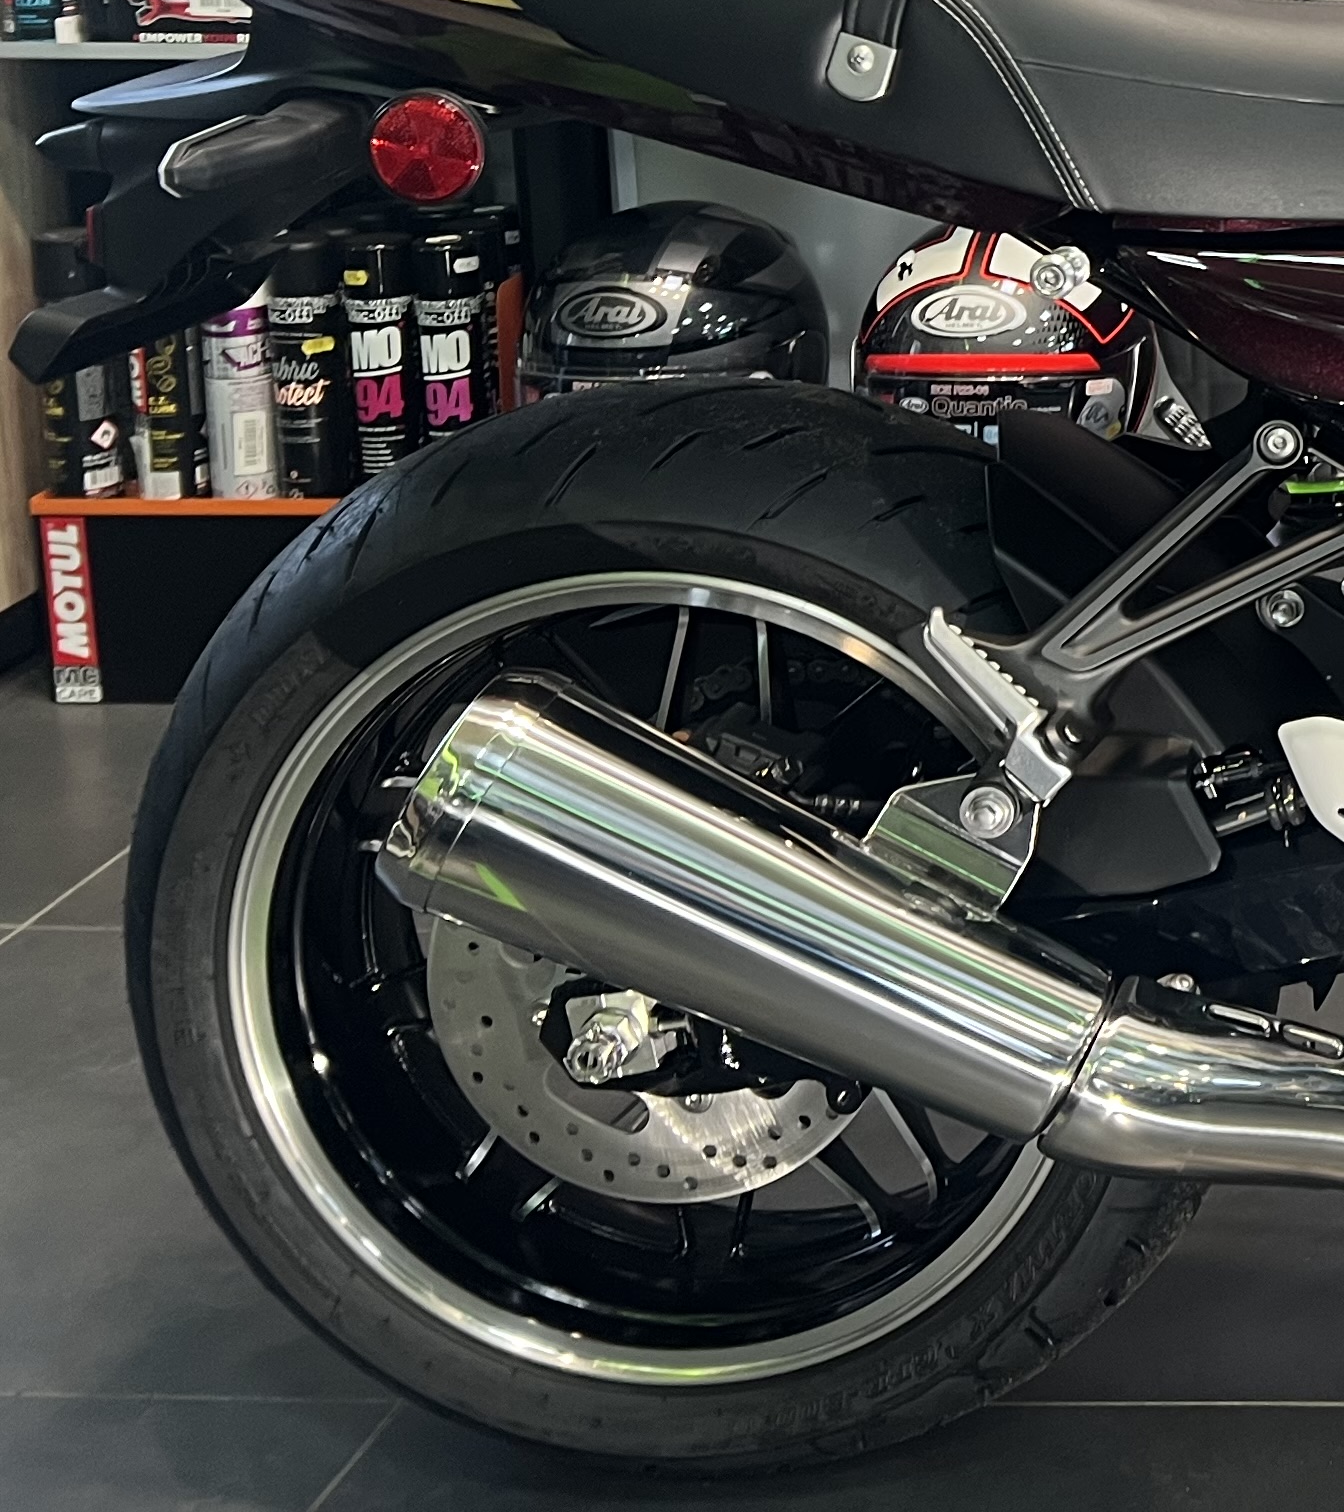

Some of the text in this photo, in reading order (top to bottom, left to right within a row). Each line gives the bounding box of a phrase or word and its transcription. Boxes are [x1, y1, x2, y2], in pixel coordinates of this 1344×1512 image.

[569, 296, 645, 324] Arai
[935, 297, 1003, 322] Arai
[272, 356, 319, 380] abric
[351, 325, 402, 371] MO
[420, 329, 471, 374] MO
[274, 379, 332, 407] otect
[355, 374, 405, 423] 94
[425, 377, 474, 426] 94
[48, 524, 90, 659] MOTUL
